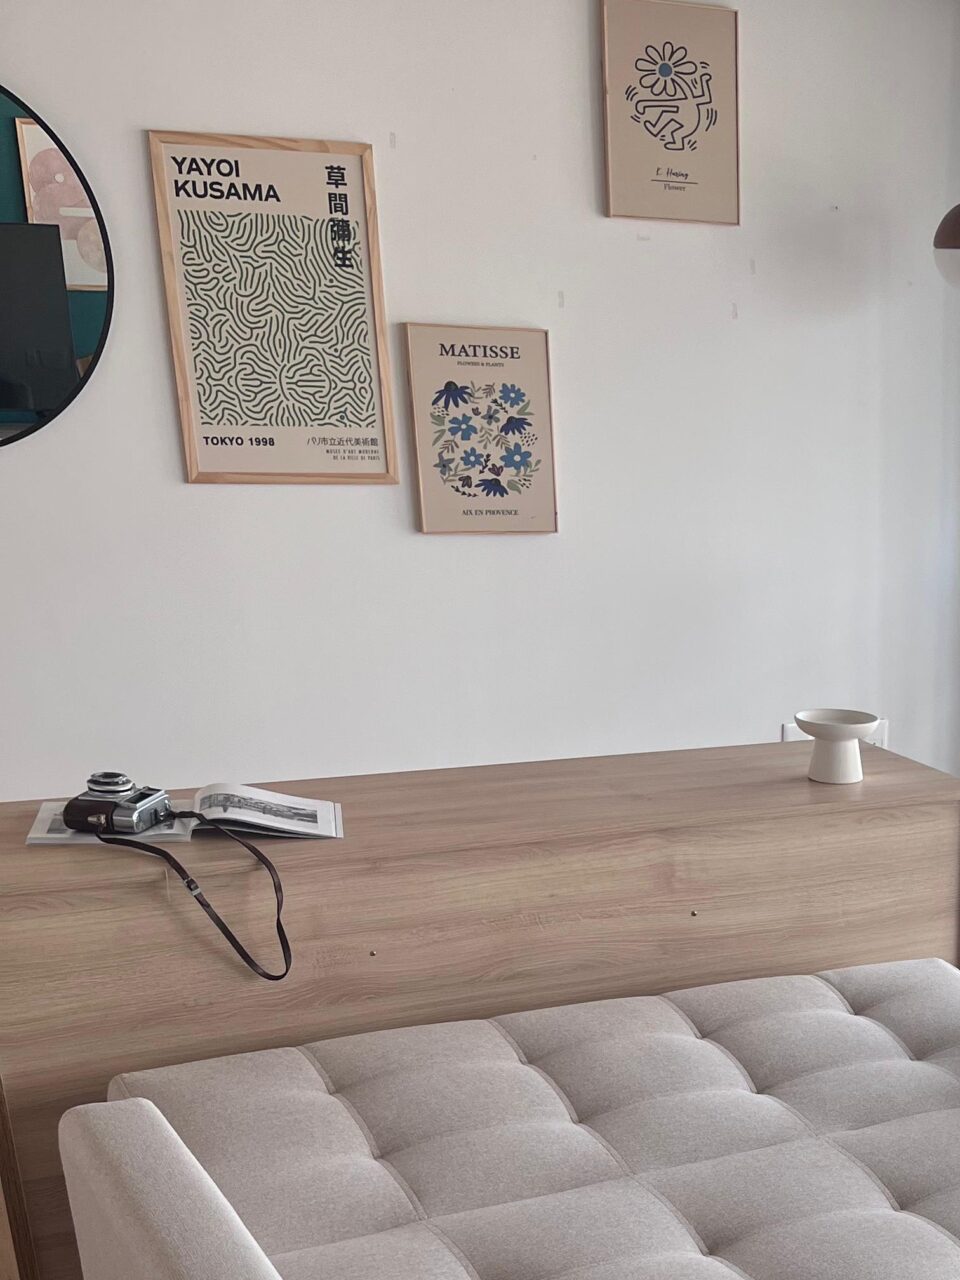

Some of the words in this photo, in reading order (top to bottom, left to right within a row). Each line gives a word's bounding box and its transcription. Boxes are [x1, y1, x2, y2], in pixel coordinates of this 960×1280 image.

[171, 156, 240, 177] YAYOI
[174, 180, 281, 202] KUSAMA
[439, 343, 521, 359] MATISSE
[203, 436, 244, 446] TOKYO
[248, 437, 275, 446] 1998
